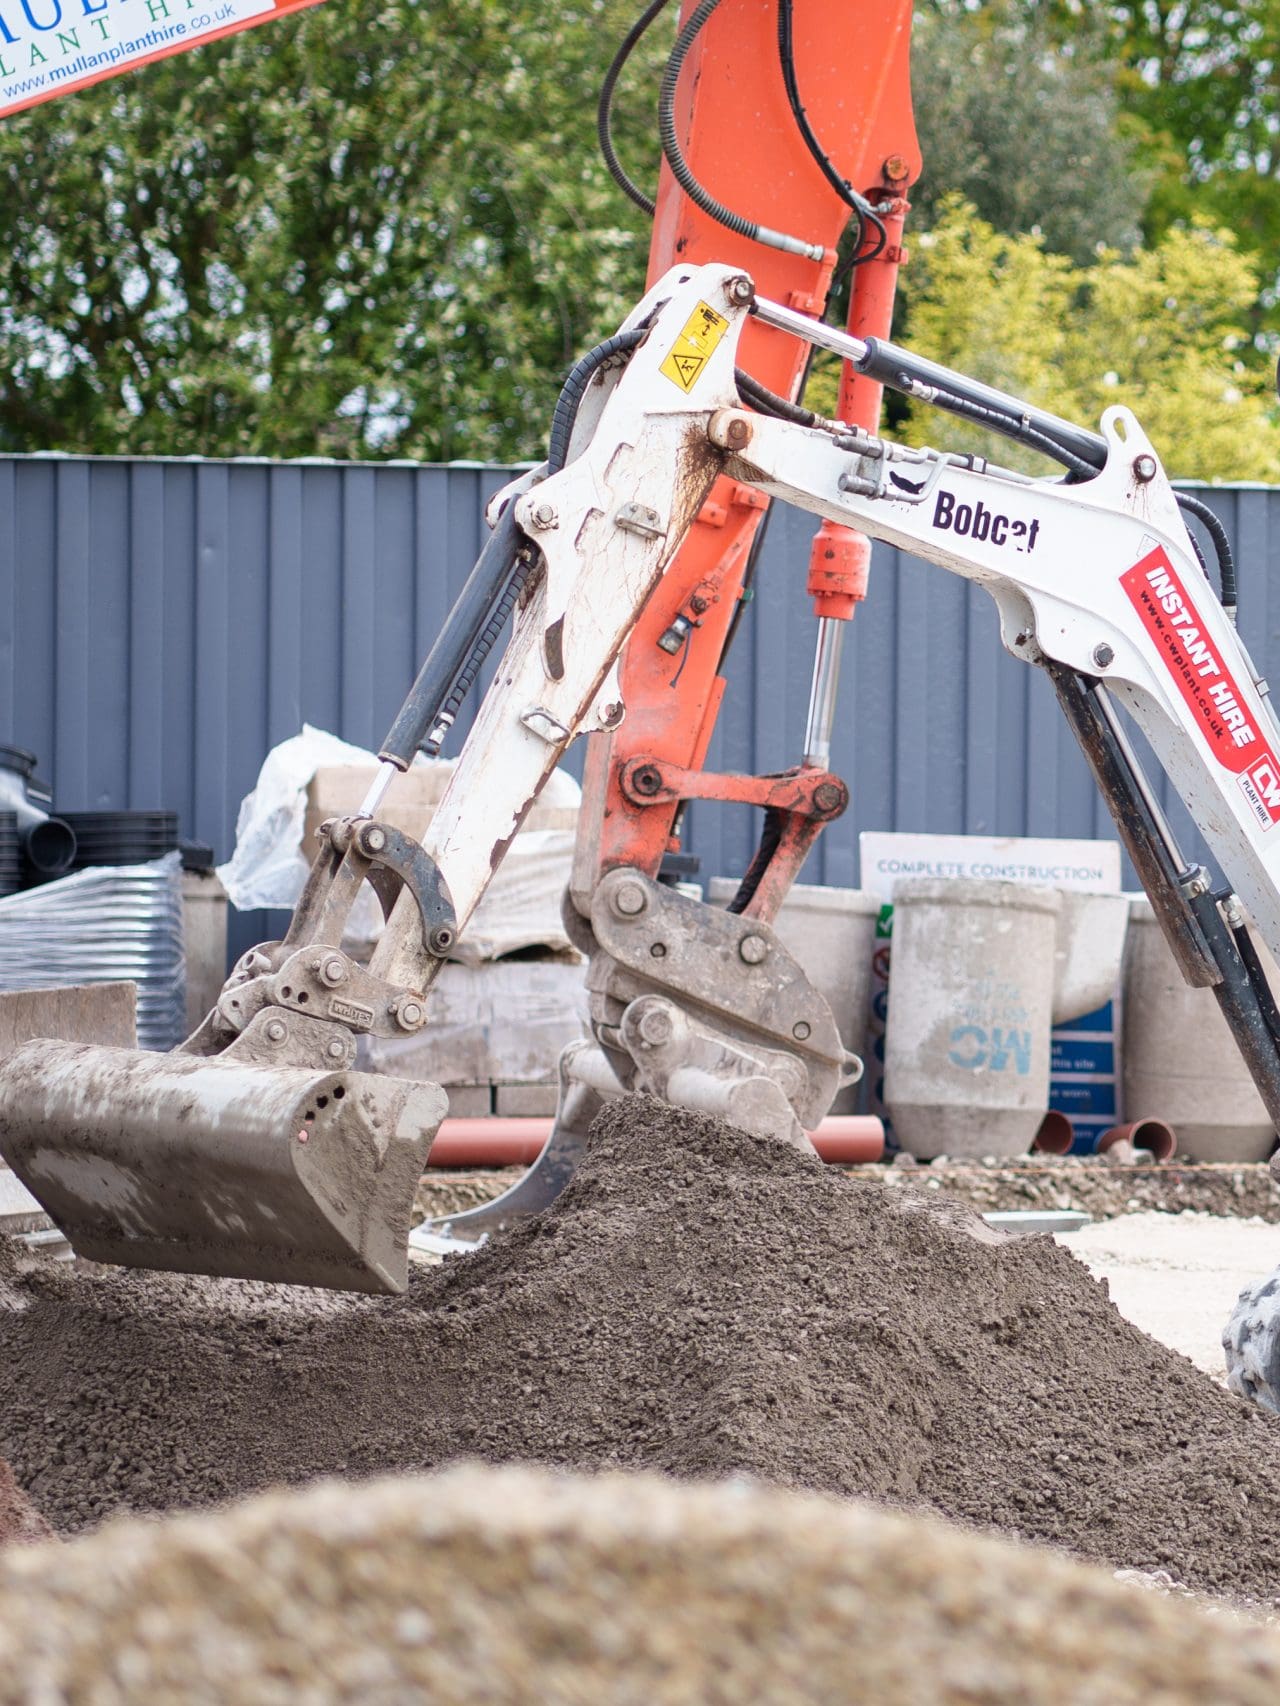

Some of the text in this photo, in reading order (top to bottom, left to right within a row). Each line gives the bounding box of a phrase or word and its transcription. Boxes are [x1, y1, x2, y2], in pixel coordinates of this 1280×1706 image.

[3, 3, 236, 97] www.mullanplanthire.co.uk
[1140, 590, 1223, 740] www.cwplant.co.uk
[1145, 566, 1255, 748] INSTANT HIRE
[1243, 780, 1270, 824] PLANT HIRE
[877, 859, 1103, 881] COMPLETE CONSTRUCTION
